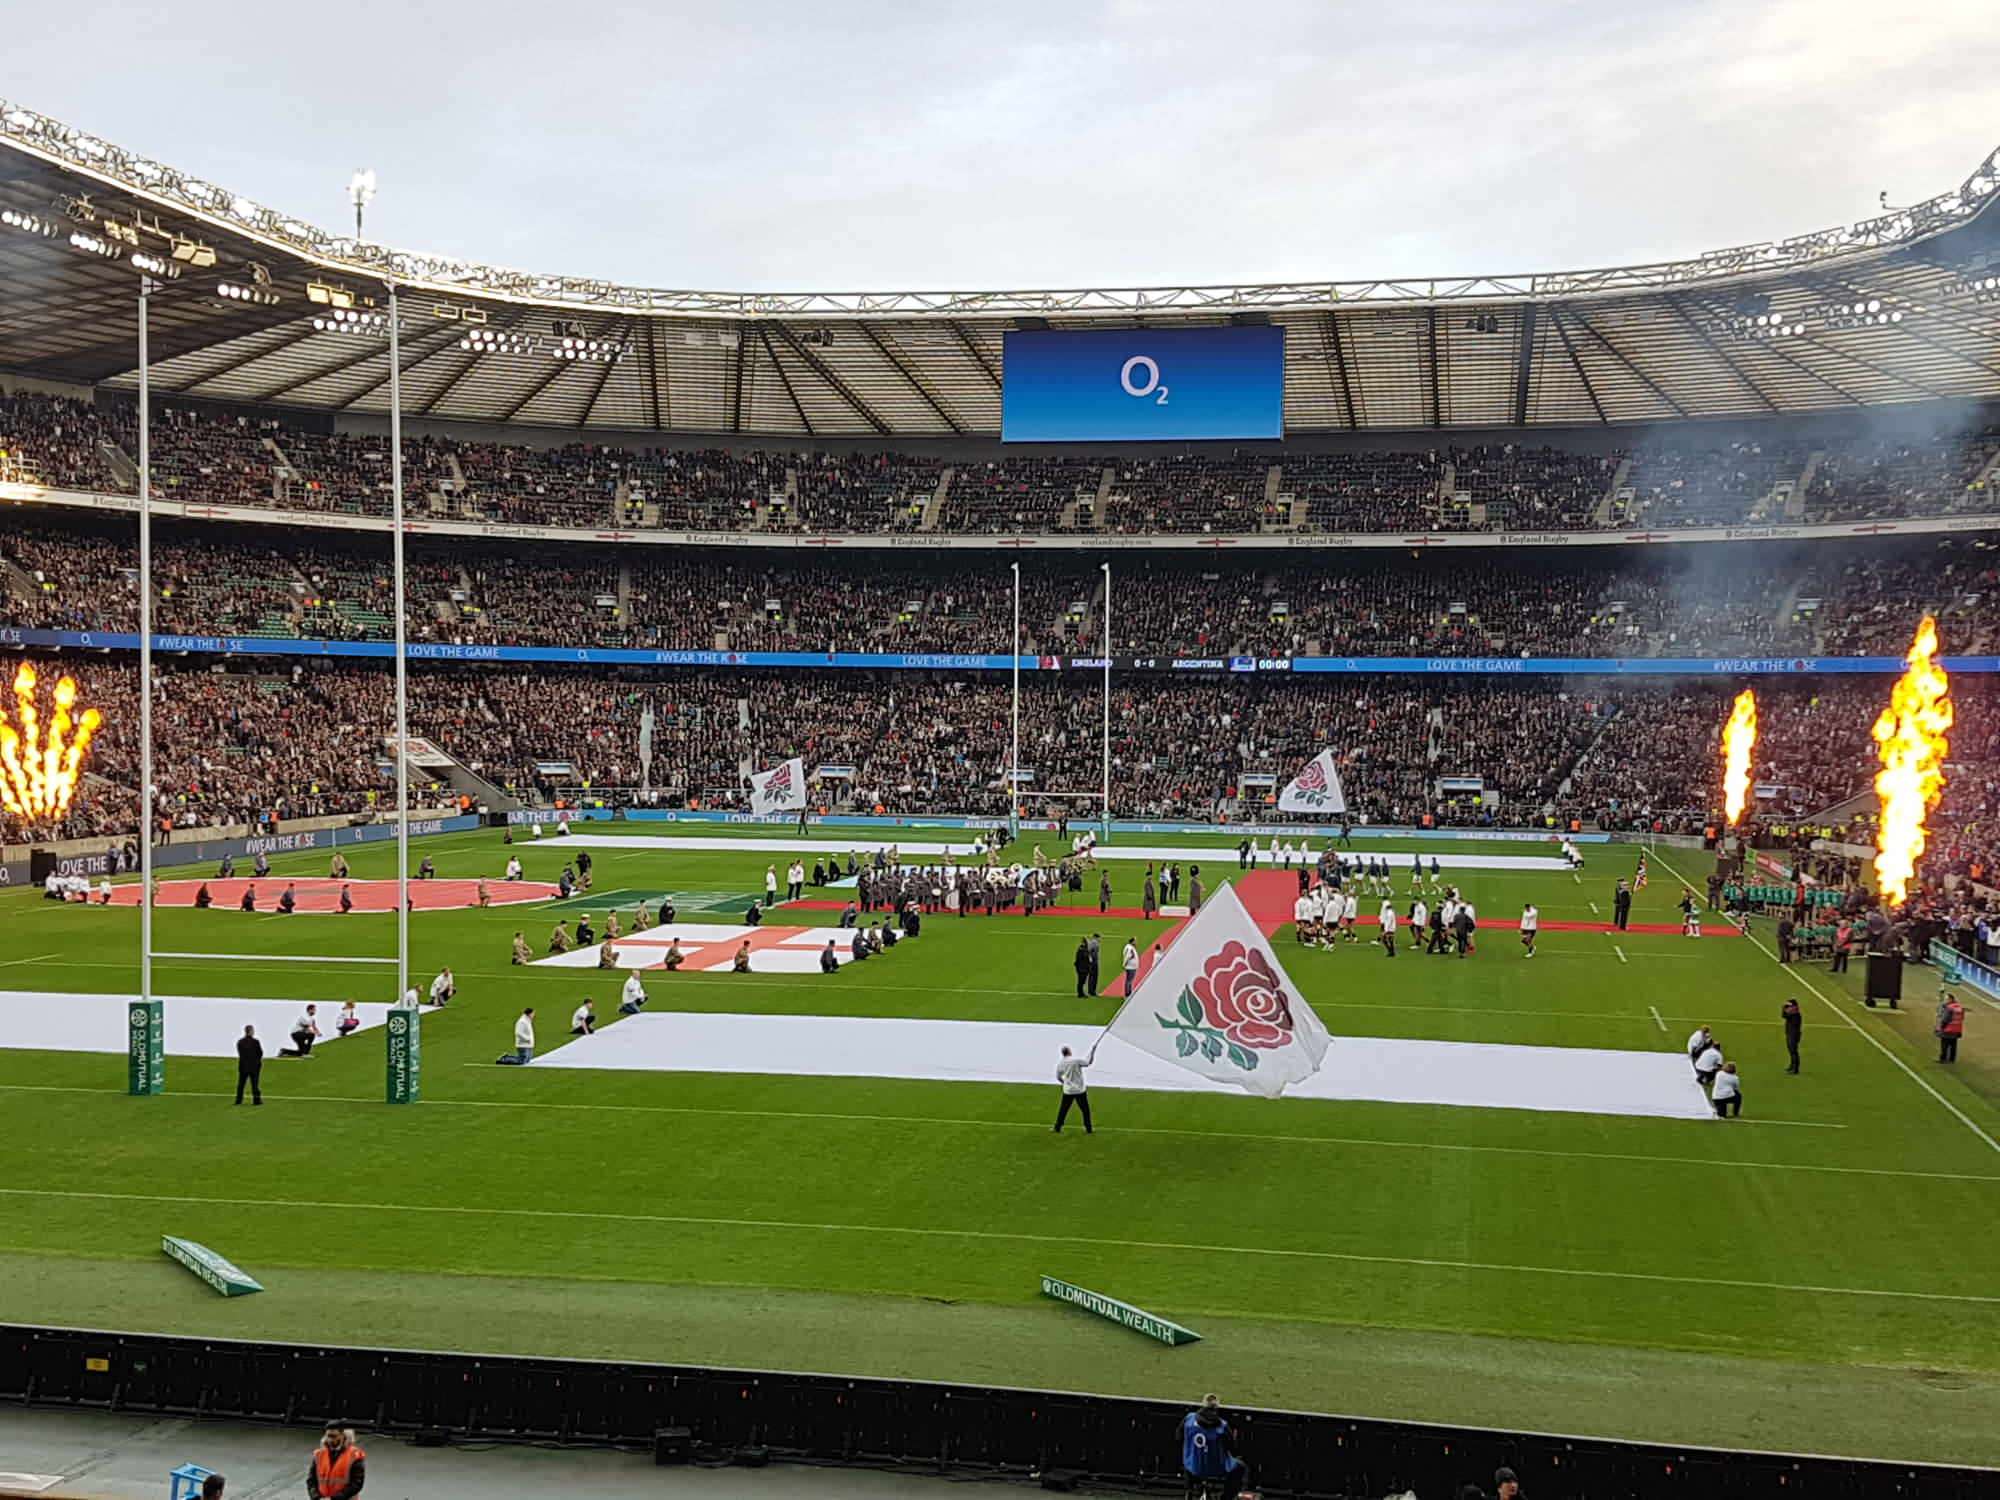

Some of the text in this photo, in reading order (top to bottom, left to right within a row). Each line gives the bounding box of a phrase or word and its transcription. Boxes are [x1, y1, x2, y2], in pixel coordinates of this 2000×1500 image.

[160, 638, 194, 649] #WEAR
[197, 639, 214, 650] THE
[408, 644, 501, 657] LOVE THE GAME
[655, 652, 695, 663] #WEAR
[698, 653, 717, 664] THE
[902, 655, 988, 667] LOVE THE GAME
[1258, 659, 1290, 670] 00:00
[1427, 660, 1522, 672] LOVE THE GAME
[1713, 661, 1758, 672] #WEAR
[1761, 661, 1785, 672] THE
[527, 811, 550, 823] THE
[724, 814, 754, 824] LOVE
[760, 814, 782, 825] THE
[245, 838, 277, 854] #WEAR
[278, 835, 294, 849] THE
[57, 857, 85, 875] OVE
[87, 855, 107, 873] THE
[1051, 1282, 1173, 1345] OLDMUTUAL WEALTH
